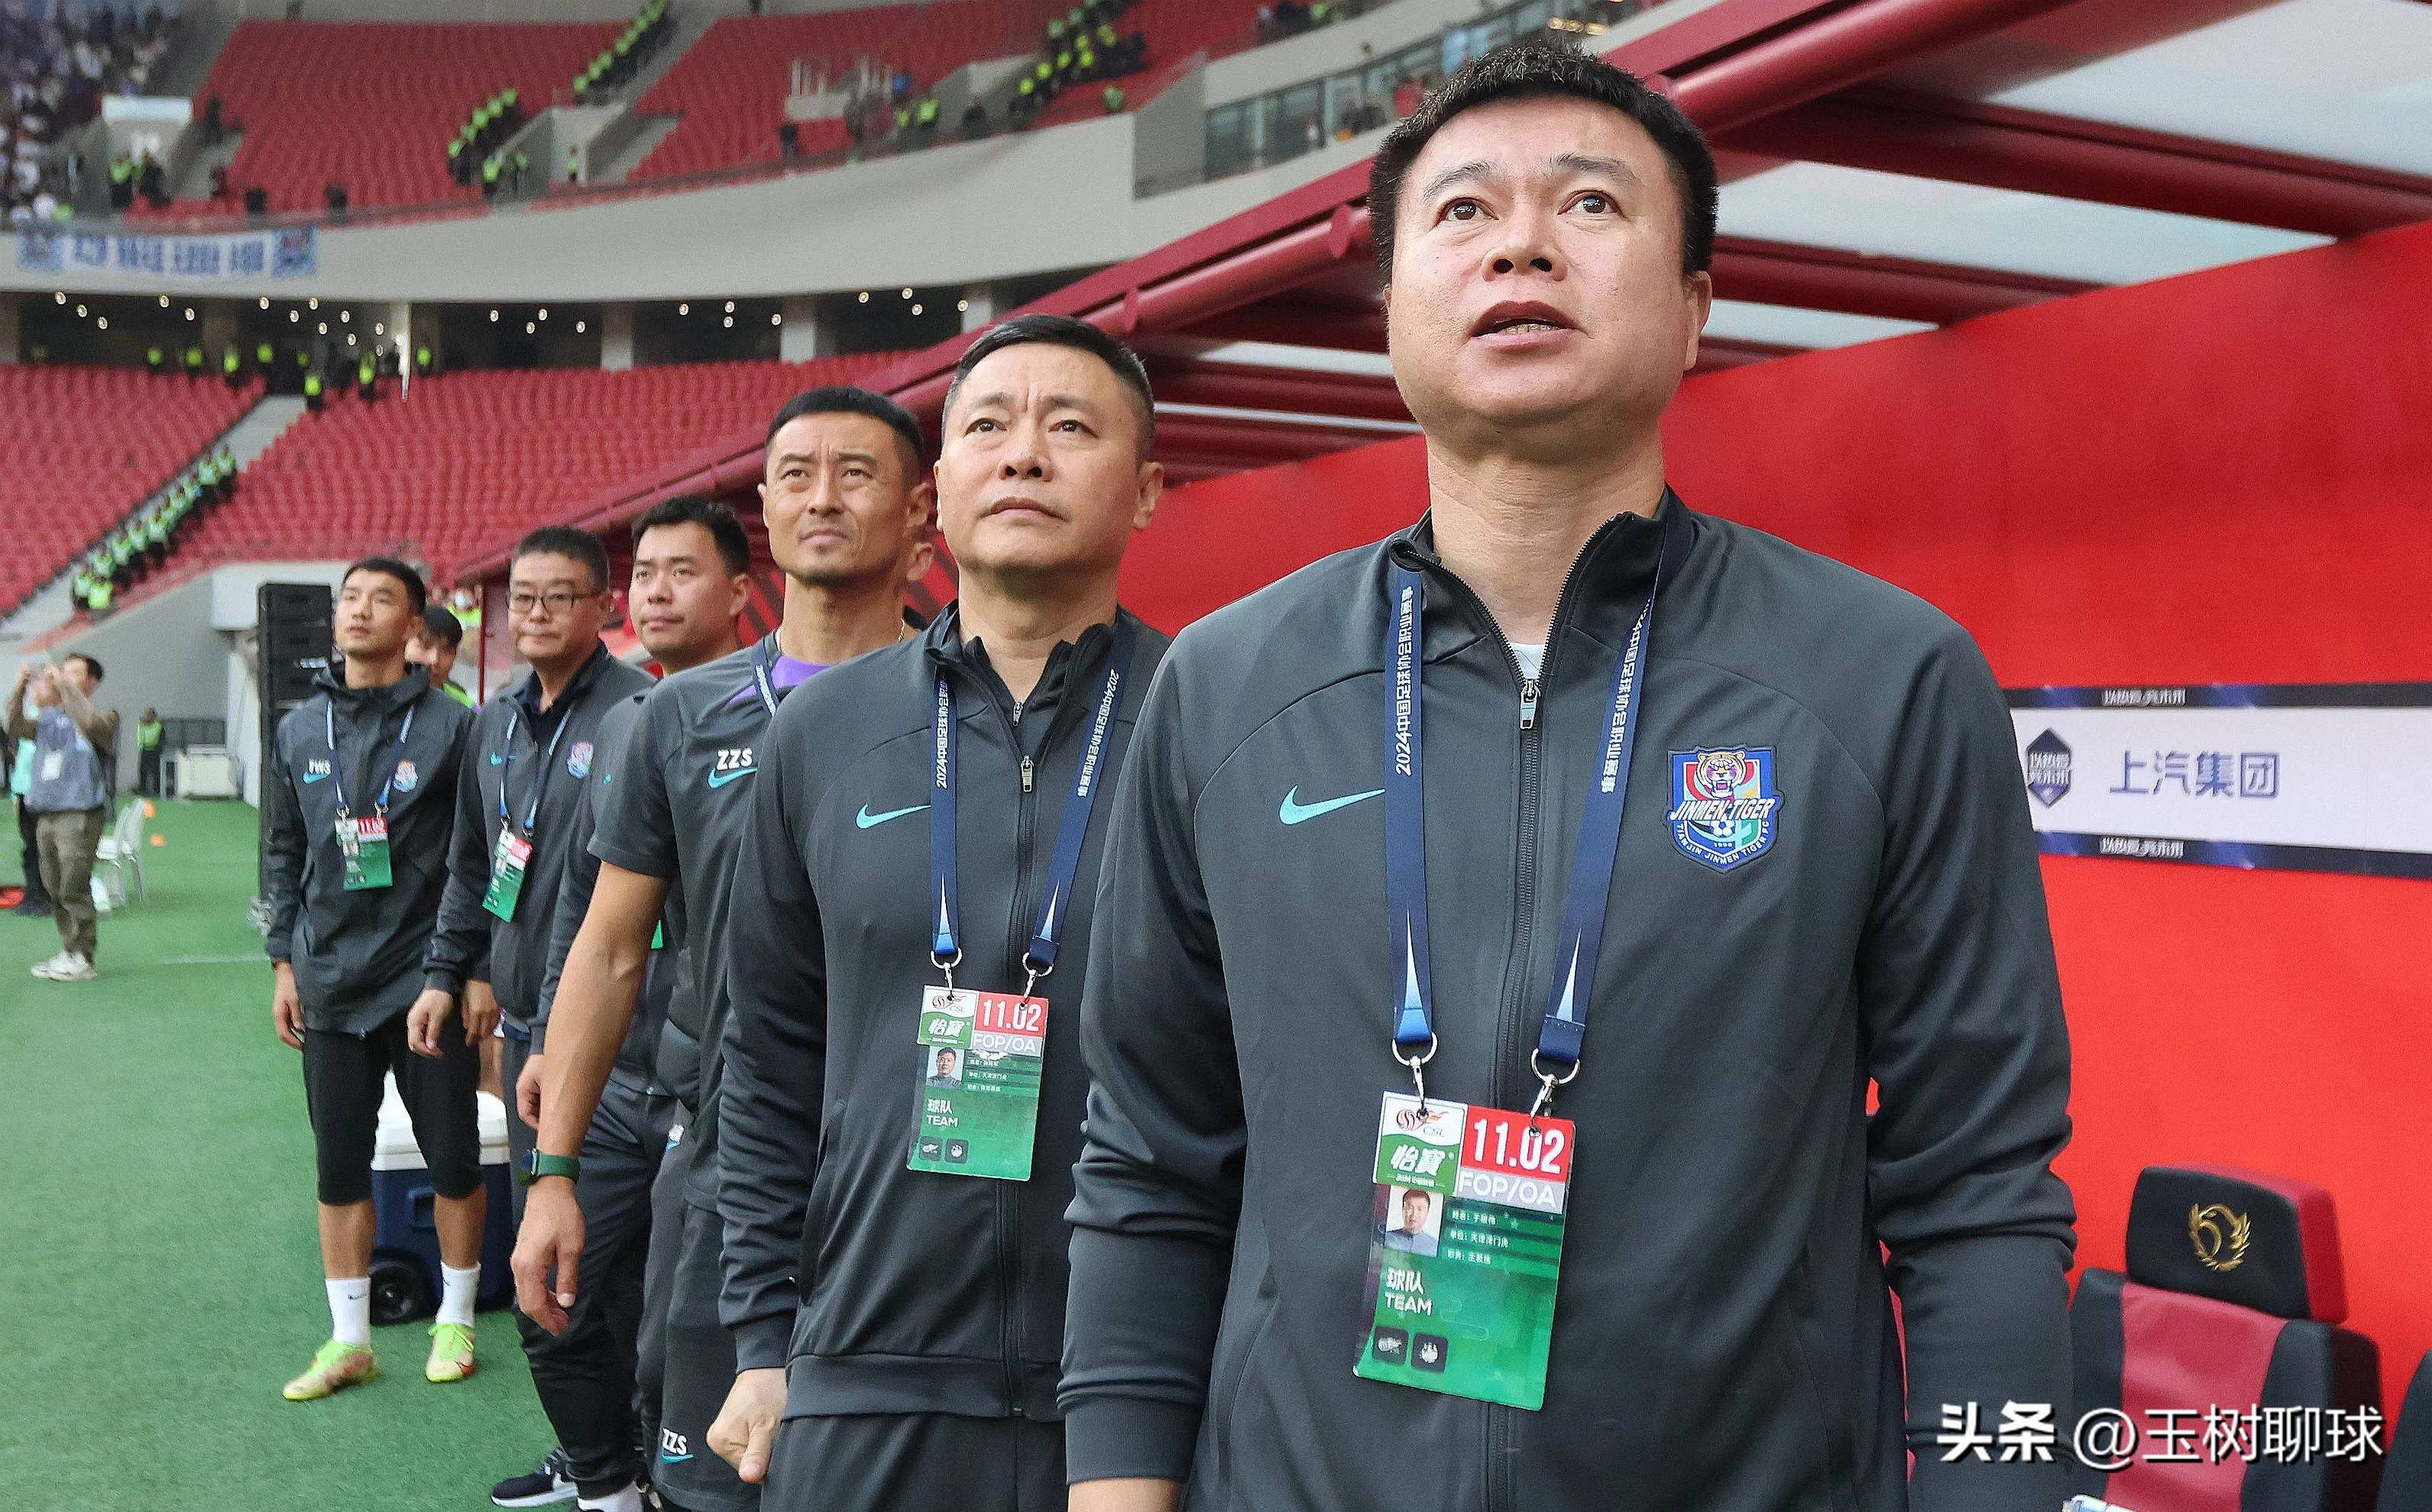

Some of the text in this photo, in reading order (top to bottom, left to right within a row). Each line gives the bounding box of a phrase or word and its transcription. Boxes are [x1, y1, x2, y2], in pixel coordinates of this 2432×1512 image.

[1601, 599, 1651, 794] 24中国足球协会职业赛事
[716, 747, 753, 771] ZZS
[2110, 750, 2281, 799] 上汽集团
[1669, 798, 1776, 821] JINMEN TIGER
[1676, 824, 1703, 854] TIANJIN
[1705, 852, 1740, 865] JINMEN
[1740, 837, 1767, 856] TIGER
[983, 999, 1041, 1031] 11.02
[973, 1032, 1036, 1054] FOP/OA
[926, 1115, 958, 1128] TEAM
[1474, 1118, 1565, 1174] 11.02
[1459, 1170, 1556, 1208] FOP/OA
[1386, 1267, 1424, 1294] 球队
[1384, 1292, 1433, 1316] TEAM
[662, 1428, 688, 1455] ZZS
